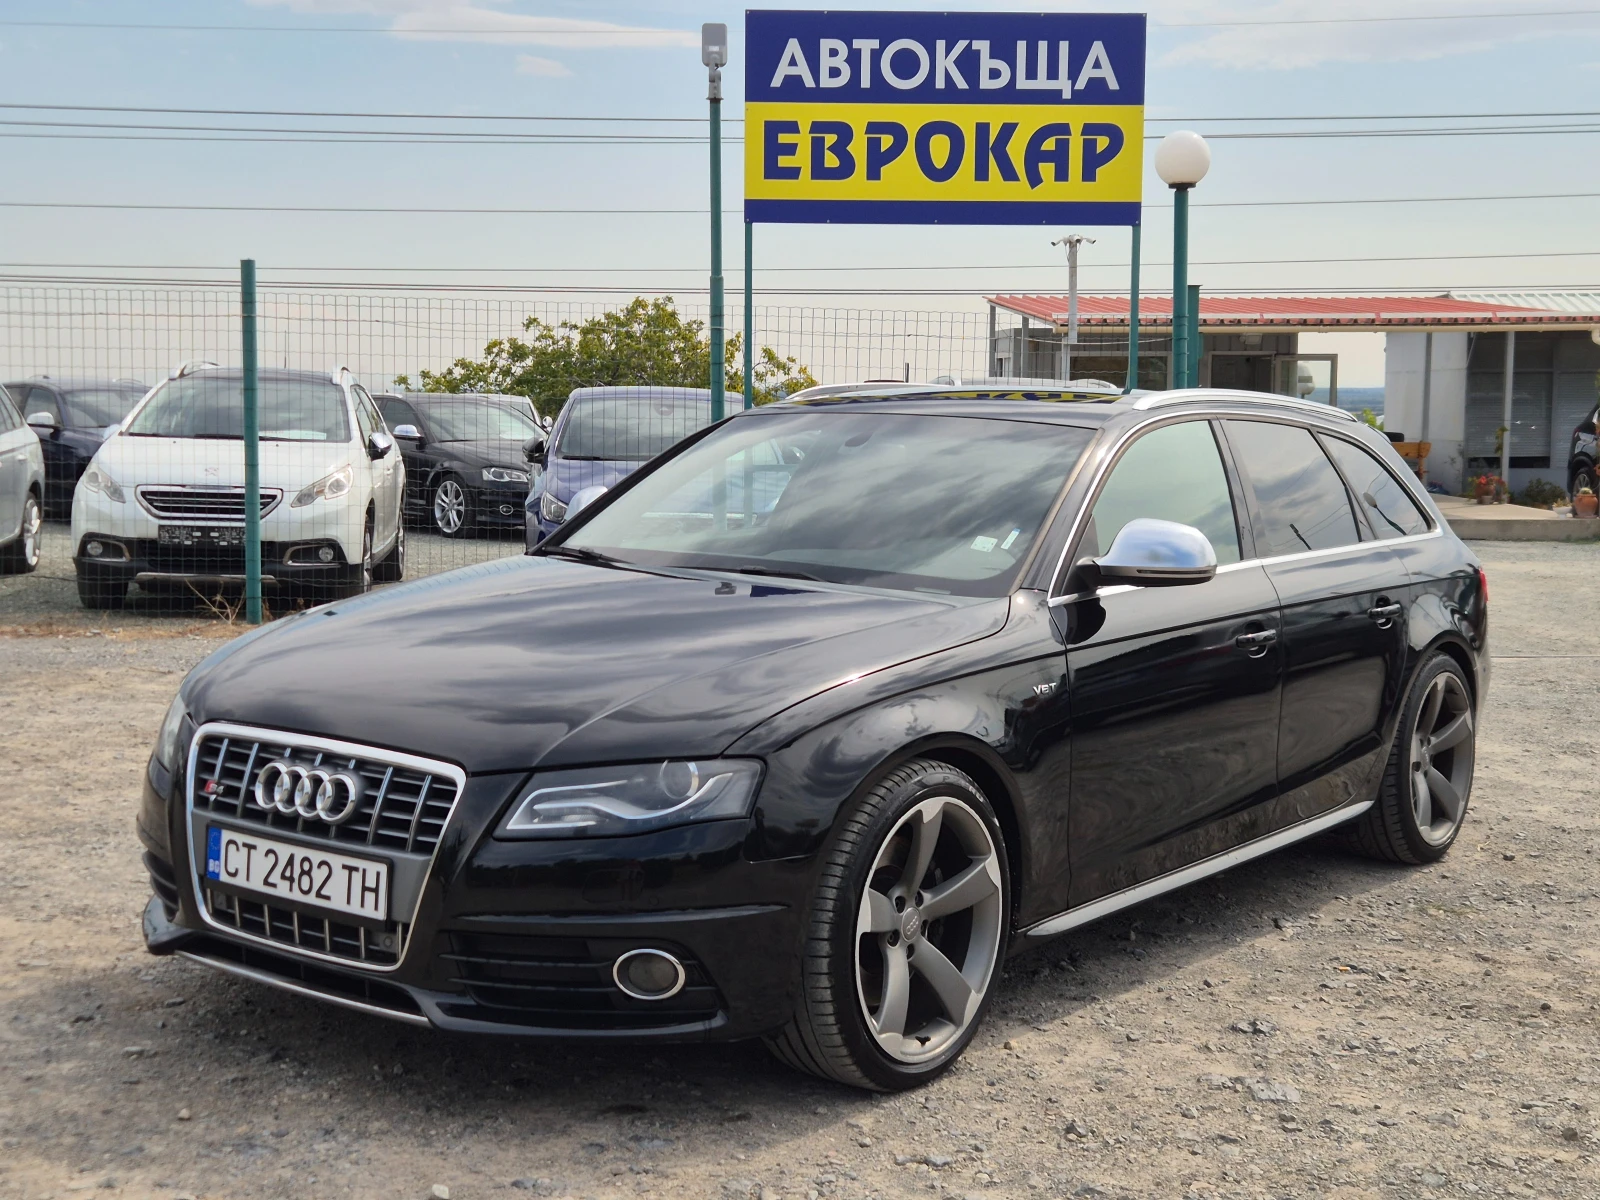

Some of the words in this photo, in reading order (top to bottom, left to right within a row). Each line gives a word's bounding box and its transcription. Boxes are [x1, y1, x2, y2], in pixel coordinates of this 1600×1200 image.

[769, 37, 1121, 100] АВТОКЪЩА
[763, 119, 1125, 190] ЕВРОКАР
[223, 839, 257, 882] CT
[262, 848, 333, 901] 2482
[341, 864, 381, 912] TH
